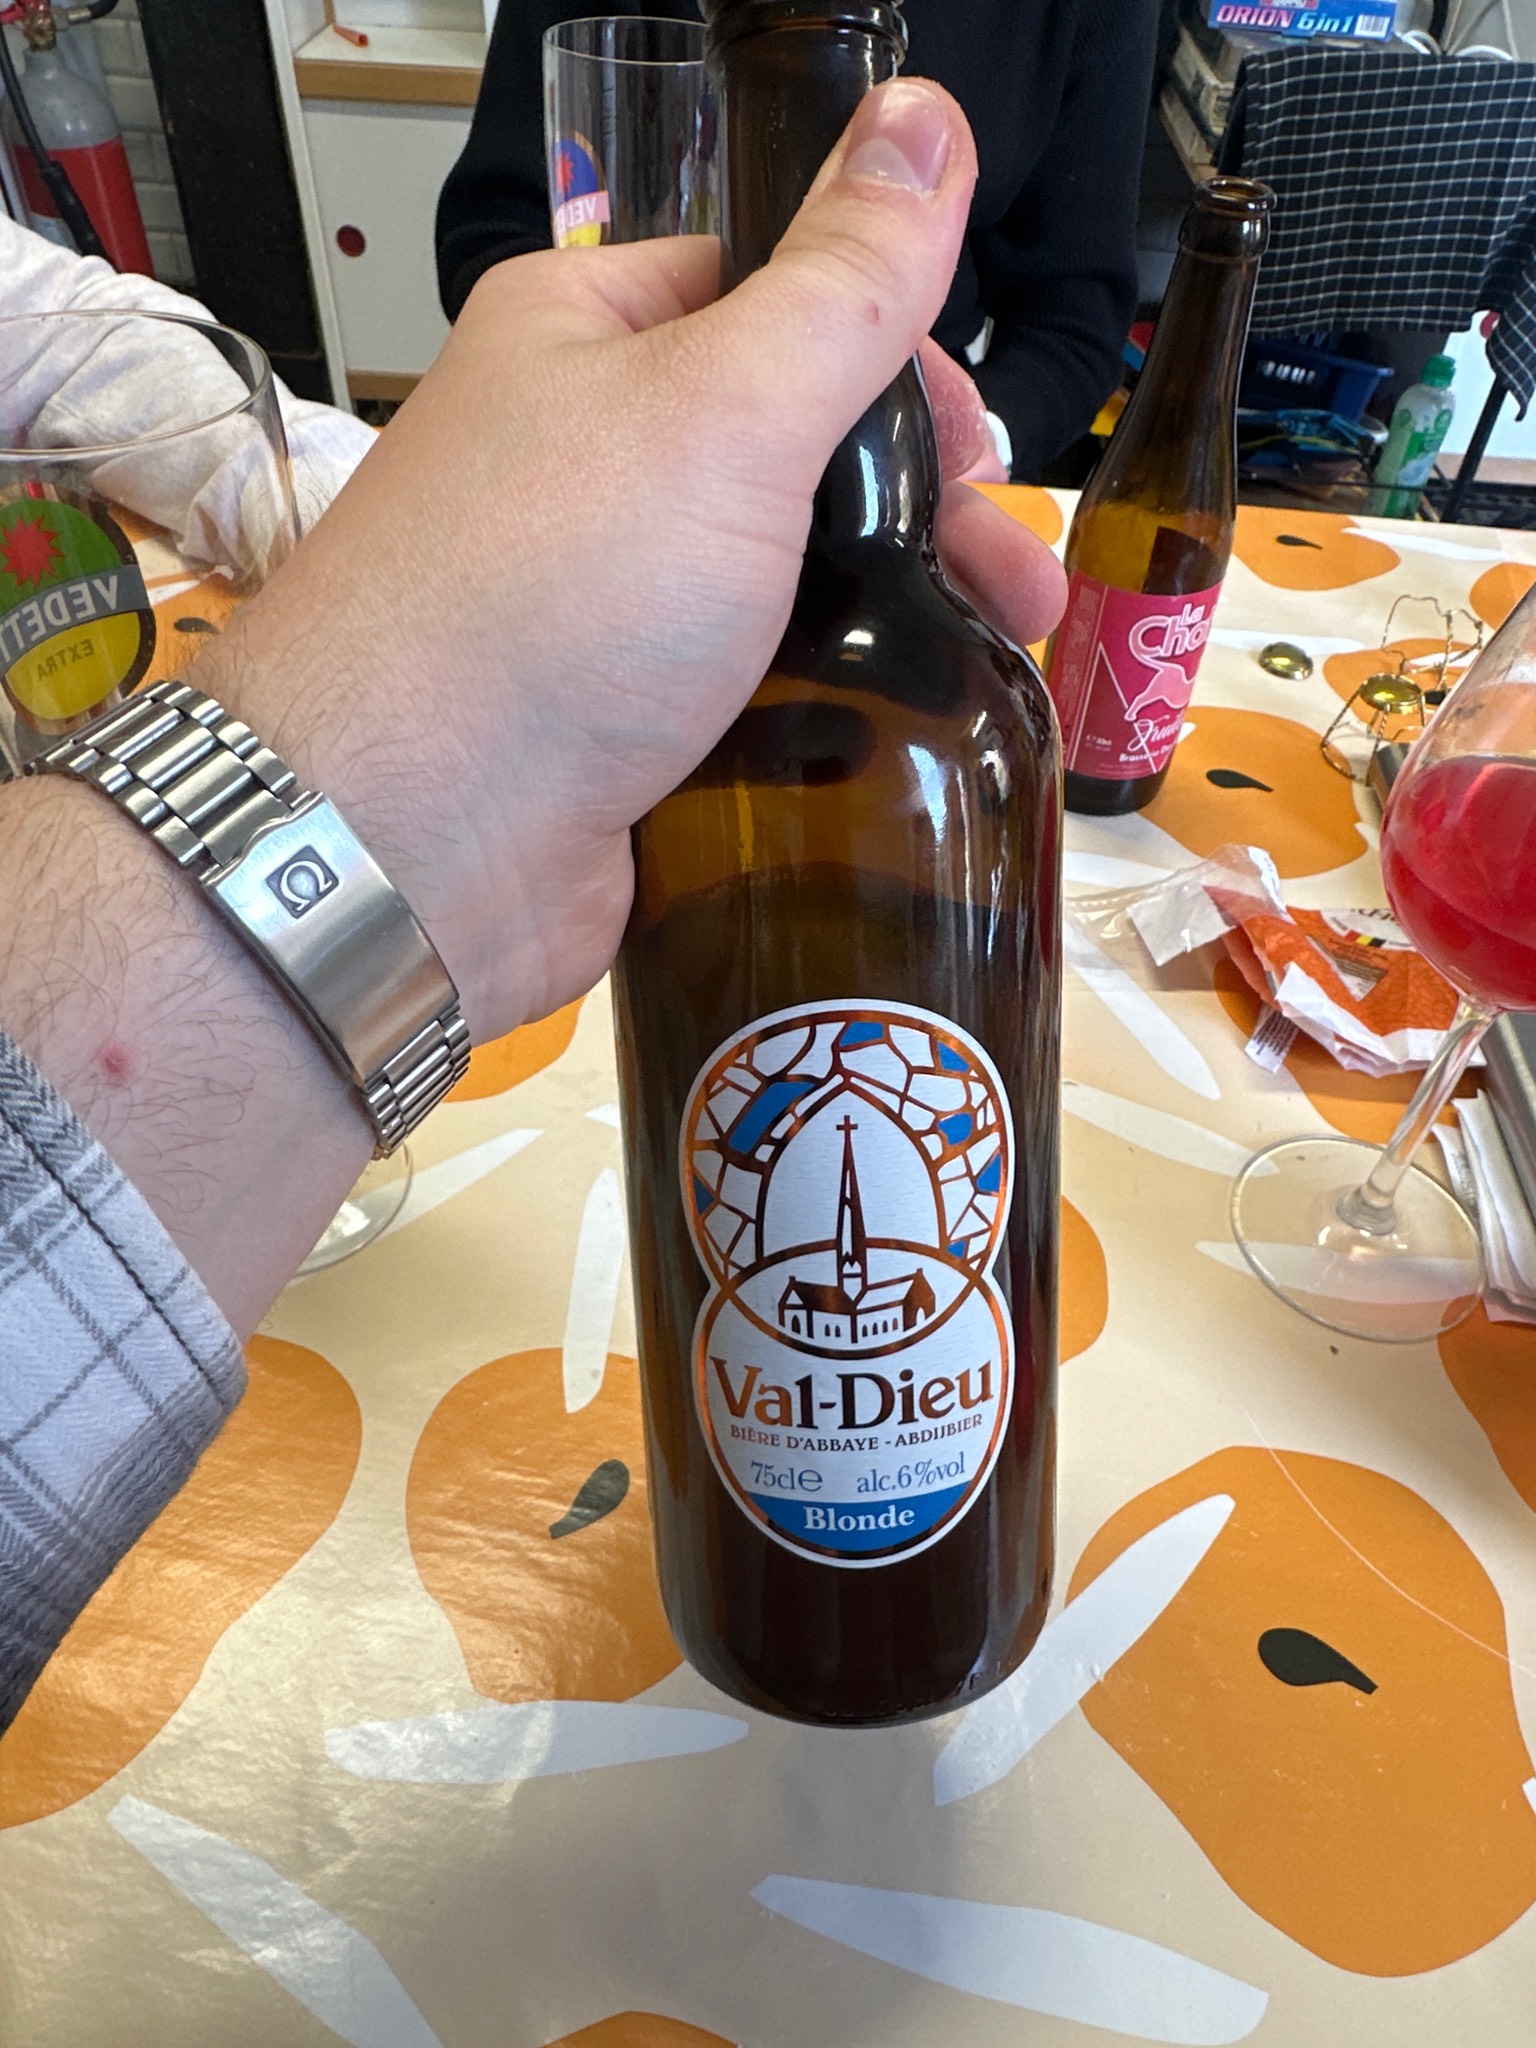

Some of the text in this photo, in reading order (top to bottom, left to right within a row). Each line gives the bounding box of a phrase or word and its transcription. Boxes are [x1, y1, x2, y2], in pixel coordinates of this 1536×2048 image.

[1216, 4, 1295, 28] ORION
[1180, 603, 1206, 626] La
[709, 1355, 994, 1430] Val-Dieu
[730, 1424, 780, 1446] BIÈRE
[786, 1436, 880, 1452] D'ABBAYE
[894, 1413, 982, 1448] ABDIJBIER
[803, 1505, 916, 1531] Blonde
